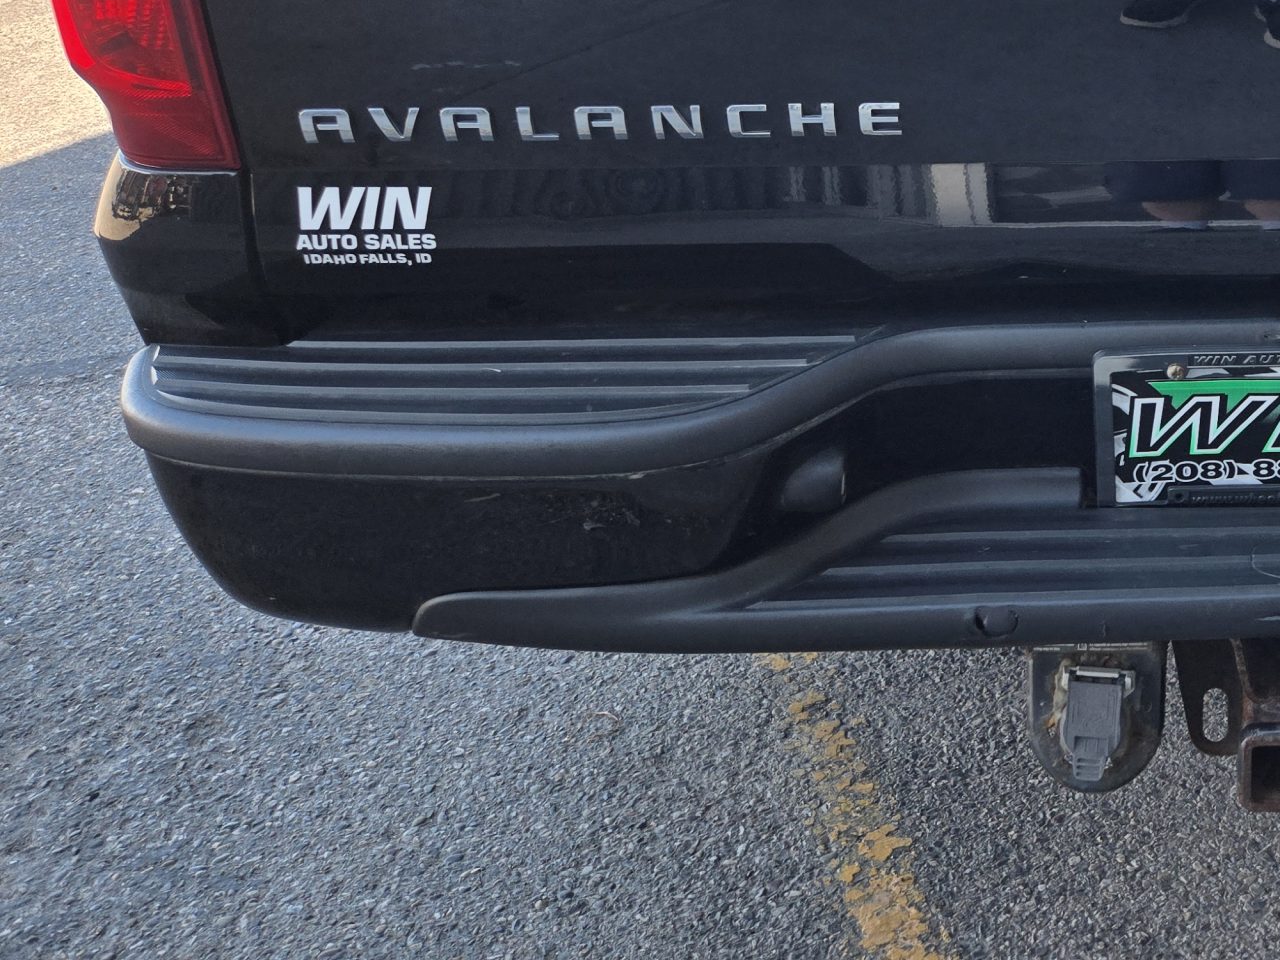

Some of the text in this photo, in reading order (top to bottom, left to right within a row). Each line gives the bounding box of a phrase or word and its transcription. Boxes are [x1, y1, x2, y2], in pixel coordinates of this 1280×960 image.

[299, 102, 903, 143] AVALANCHE
[297, 186, 432, 230] WIN
[296, 233, 437, 250] AUTO SALES
[303, 252, 432, 266] IDAHO FALLS, ID
[1193, 354, 1237, 364] WIN
[1133, 459, 1237, 483] (208)
